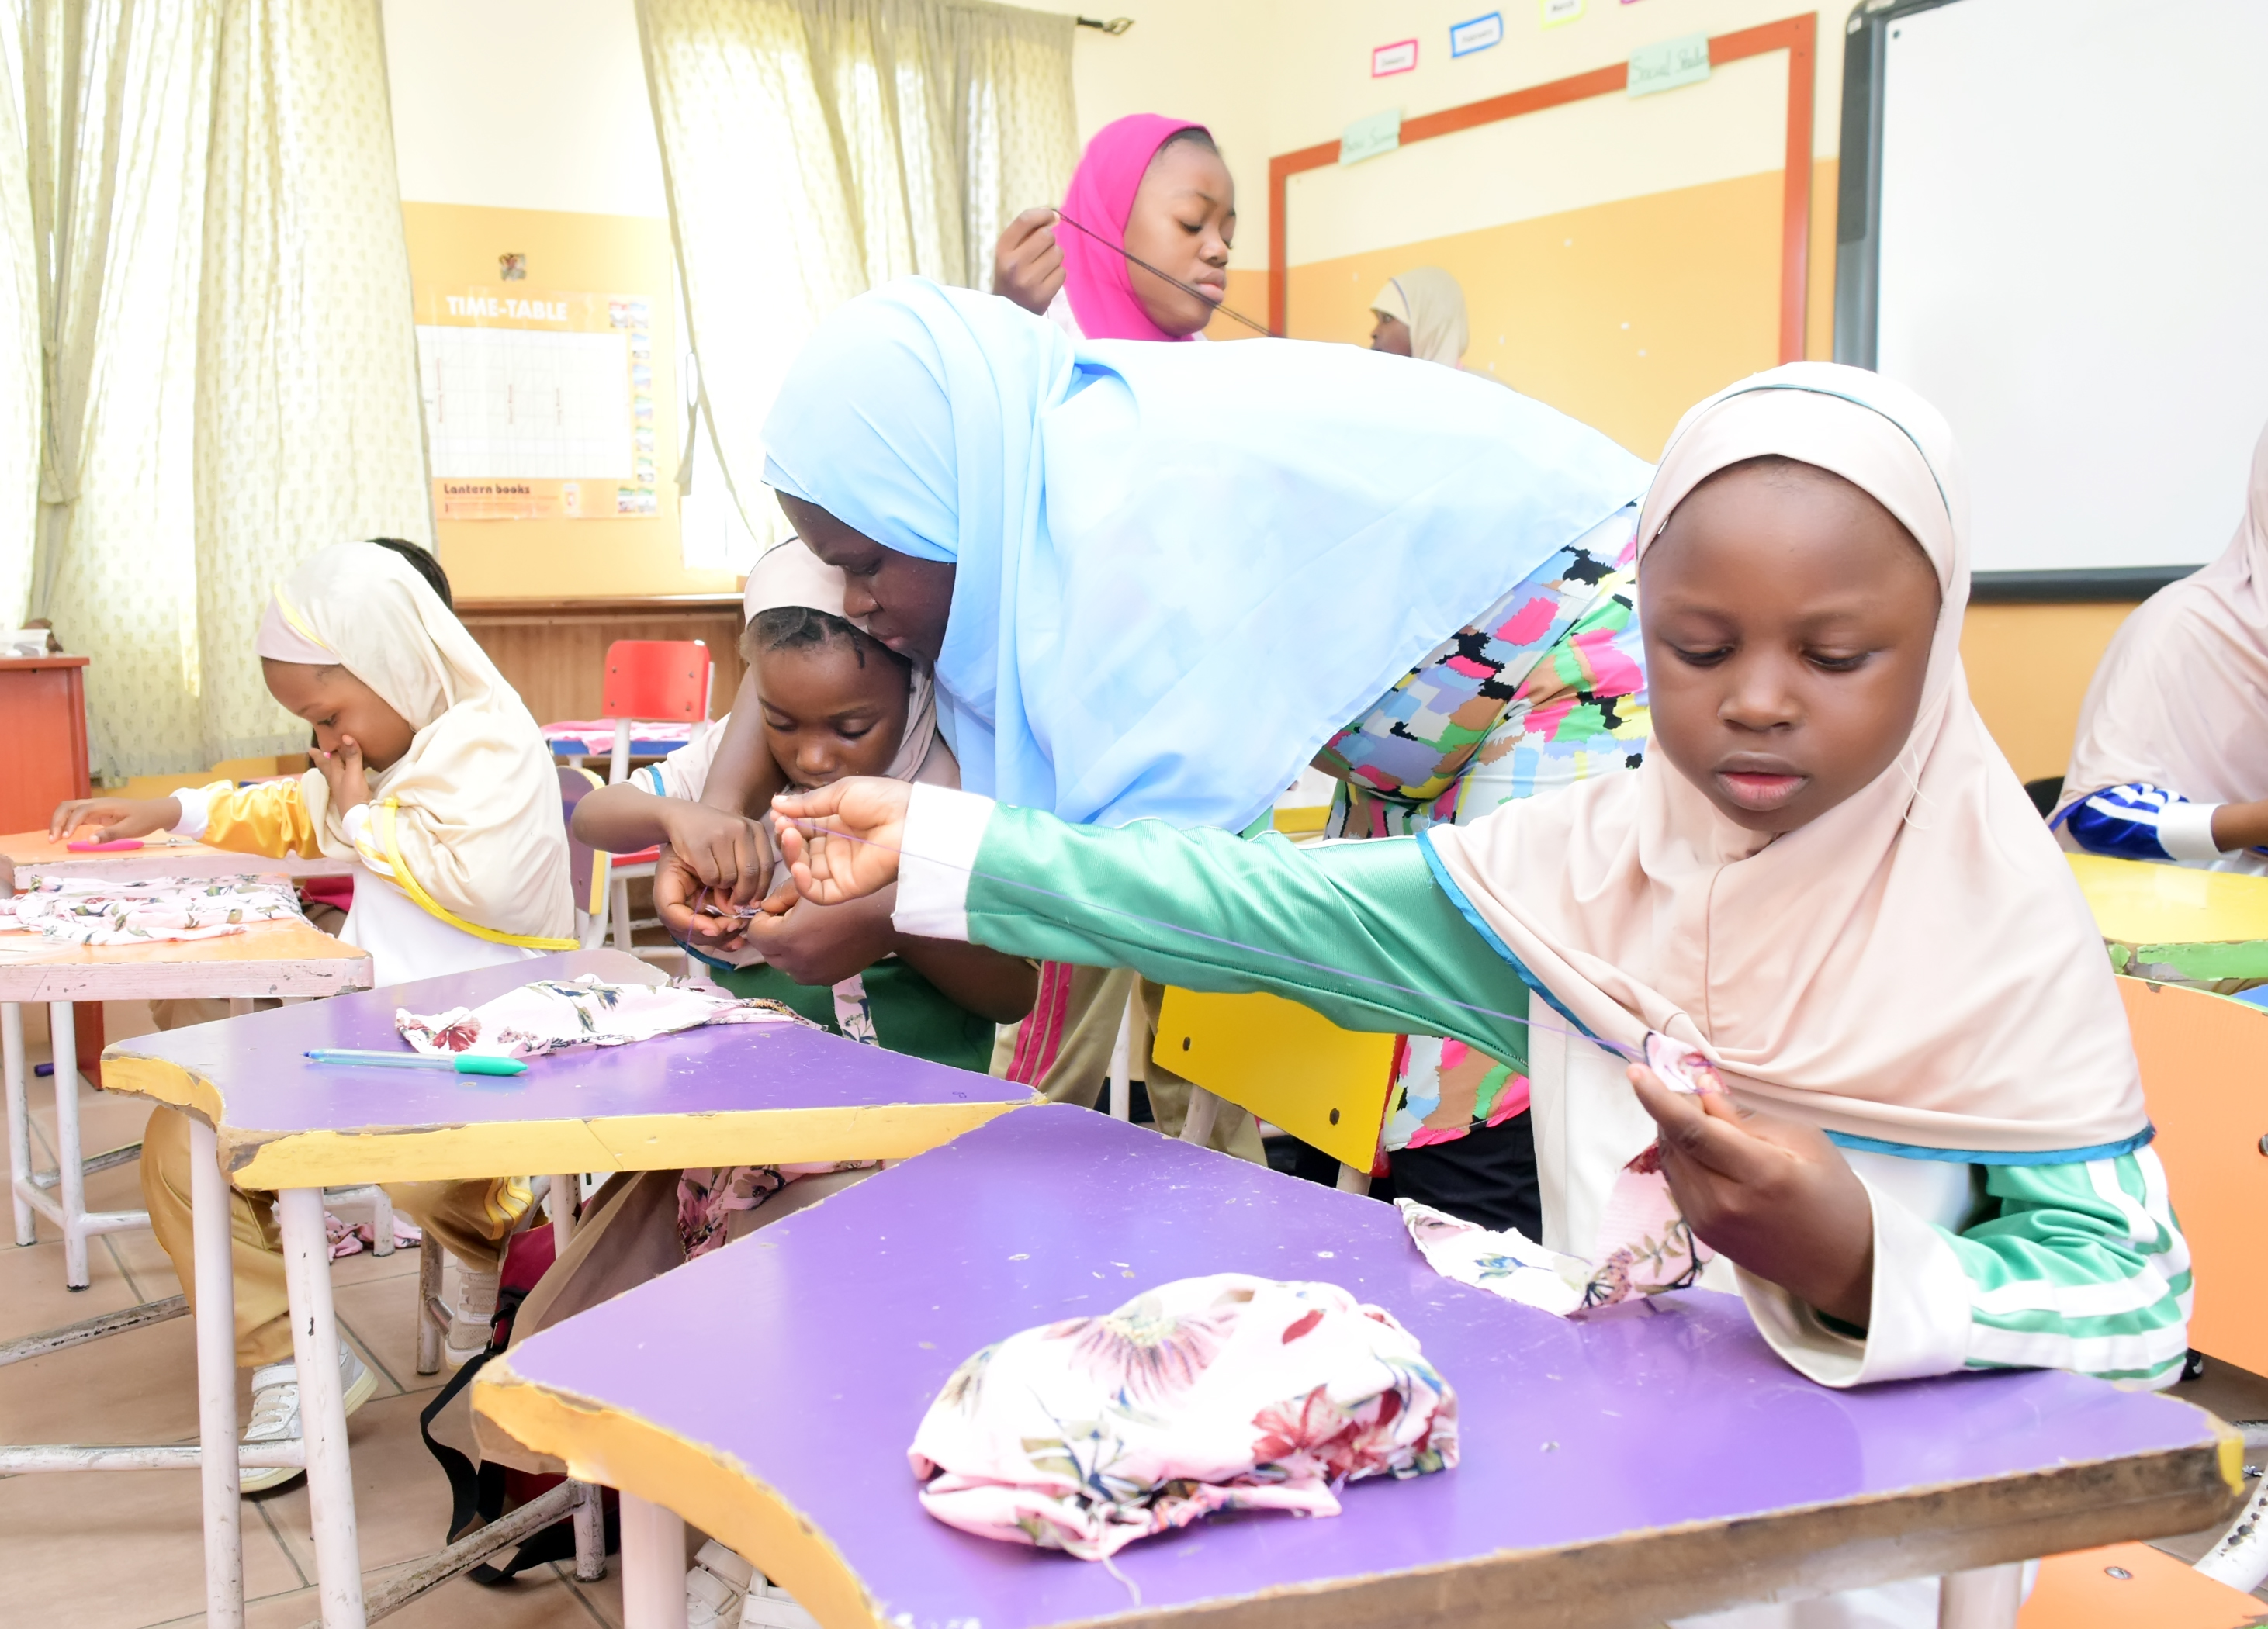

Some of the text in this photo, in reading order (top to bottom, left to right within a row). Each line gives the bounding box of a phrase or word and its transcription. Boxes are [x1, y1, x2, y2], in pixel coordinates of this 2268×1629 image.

[445, 295, 568, 321] TIME-TABLE
[444, 483, 531, 494] Lantern books
